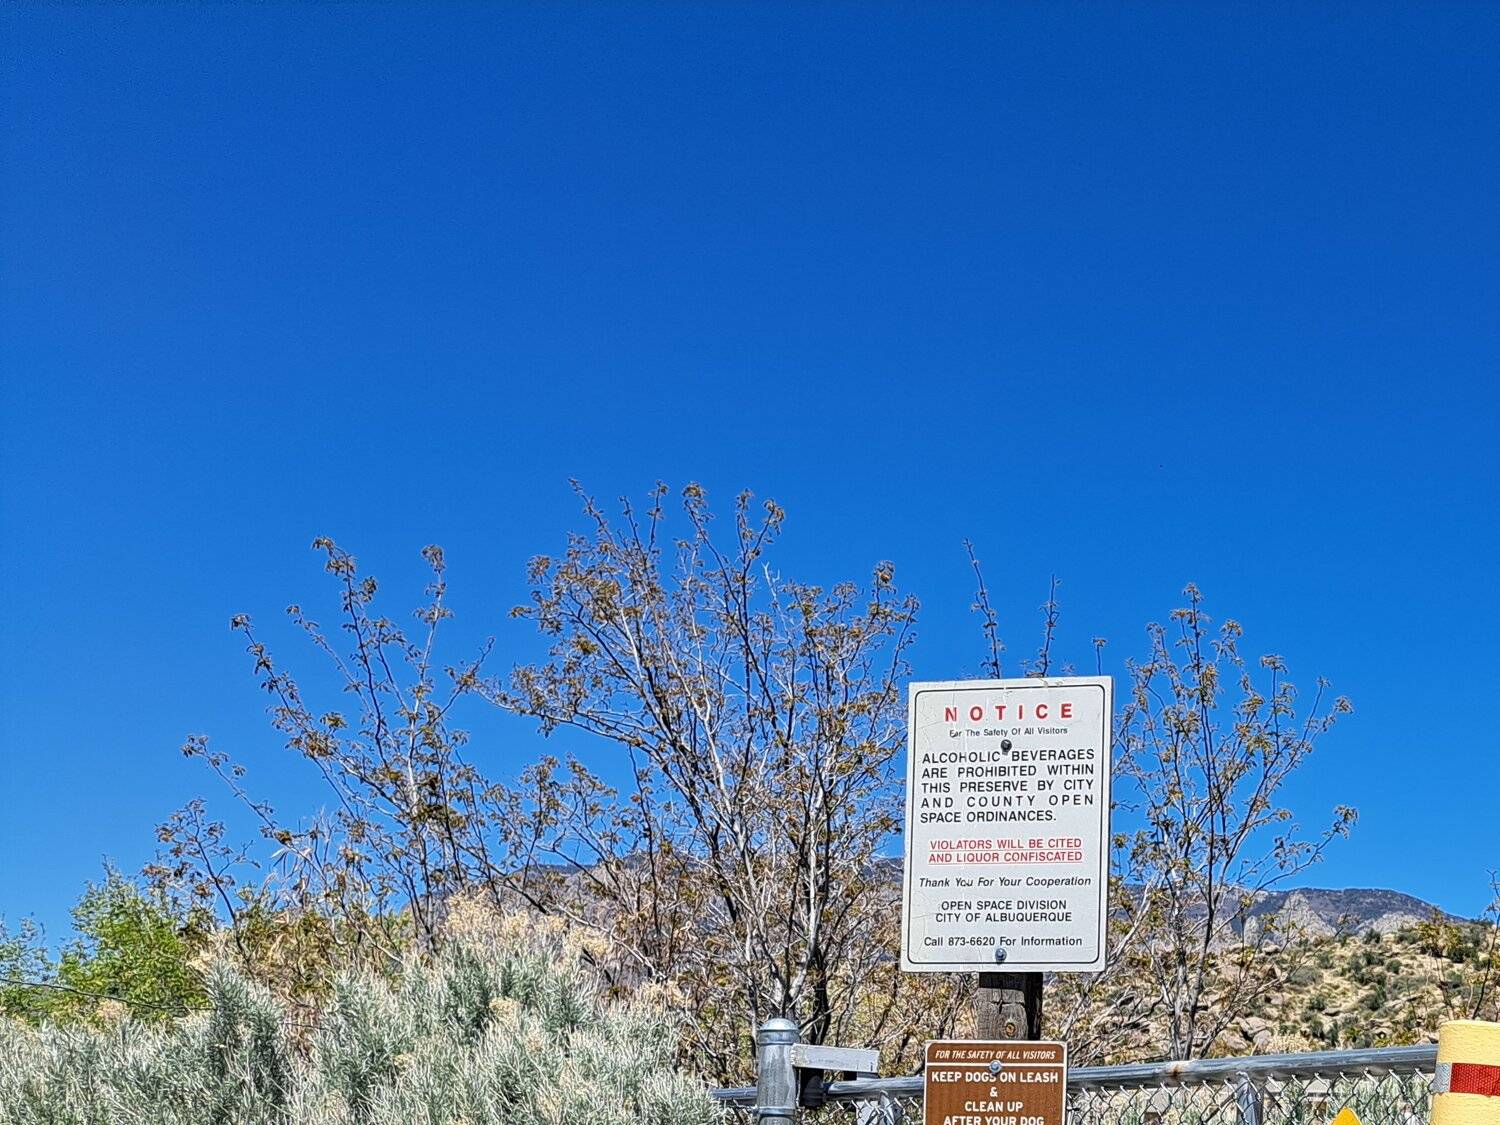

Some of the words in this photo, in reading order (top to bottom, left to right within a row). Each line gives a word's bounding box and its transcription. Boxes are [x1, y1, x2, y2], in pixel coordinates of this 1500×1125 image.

[945, 703, 1073, 722] NOTICE
[966, 729, 980, 737] The
[983, 728, 1008, 738] Safety
[1024, 727, 1034, 735] All
[1038, 726, 1068, 735] Visitors
[922, 751, 1001, 764] ALCOHOLIC
[1011, 749, 1095, 762] BEVERAGES
[922, 767, 948, 779] ARE
[957, 765, 1037, 778] PROHIBITED
[1047, 764, 1094, 776] WITHIN
[921, 782, 951, 793] THIS
[960, 780, 1028, 792] PRESERVE
[1037, 780, 1054, 791] BY
[1064, 779, 1094, 790] CITY
[921, 797, 954, 809] AND
[967, 795, 1036, 807] COUNTY
[1048, 794, 1094, 806] OPEN
[920, 812, 962, 824] SPACE
[966, 809, 1057, 823] ORDINANCES.
[930, 839, 993, 850] VIOLATORS
[997, 838, 1024, 849] WILL
[1028, 838, 1044, 849] BE
[1047, 837, 1082, 848] CITED
[928, 852, 952, 863] AND
[956, 852, 1000, 863] LIQUOR
[1004, 850, 1083, 862] CONFISCATED
[919, 877, 950, 888] Thank
[955, 877, 974, 887] You
[977, 876, 995, 887] For
[999, 876, 1022, 887] Your
[1025, 876, 1092, 888] Cooperation
[941, 901, 972, 911] OPEN
[976, 900, 1013, 910] SPACE
[1016, 900, 1067, 910] DIVISION
[935, 913, 961, 923] CITY
[965, 913, 981, 922] OF
[985, 912, 1072, 922] ALBUQUERQUE
[924, 937, 944, 947] Call
[948, 936, 996, 946] 873-6620
[1000, 936, 1017, 946] For
[1021, 936, 1083, 946] Information
[935, 1050, 949, 1059] FOR
[951, 1050, 966, 1059] THE
[967, 1050, 994, 1059] SAFETY
[995, 1051, 1007, 1059] OF
[1007, 1051, 1021, 1060] ALL
[1023, 1050, 1056, 1060] VISITORS
[931, 1071, 962, 1082] KEEP
[965, 1071, 996, 1083] DOGS
[999, 1072, 1017, 1082] ON
[1019, 1072, 1058, 1083] LEASH
[989, 1087, 998, 1098] &
[964, 1101, 1004, 1112] CLEAN
[1007, 1102, 1024, 1112] UP
